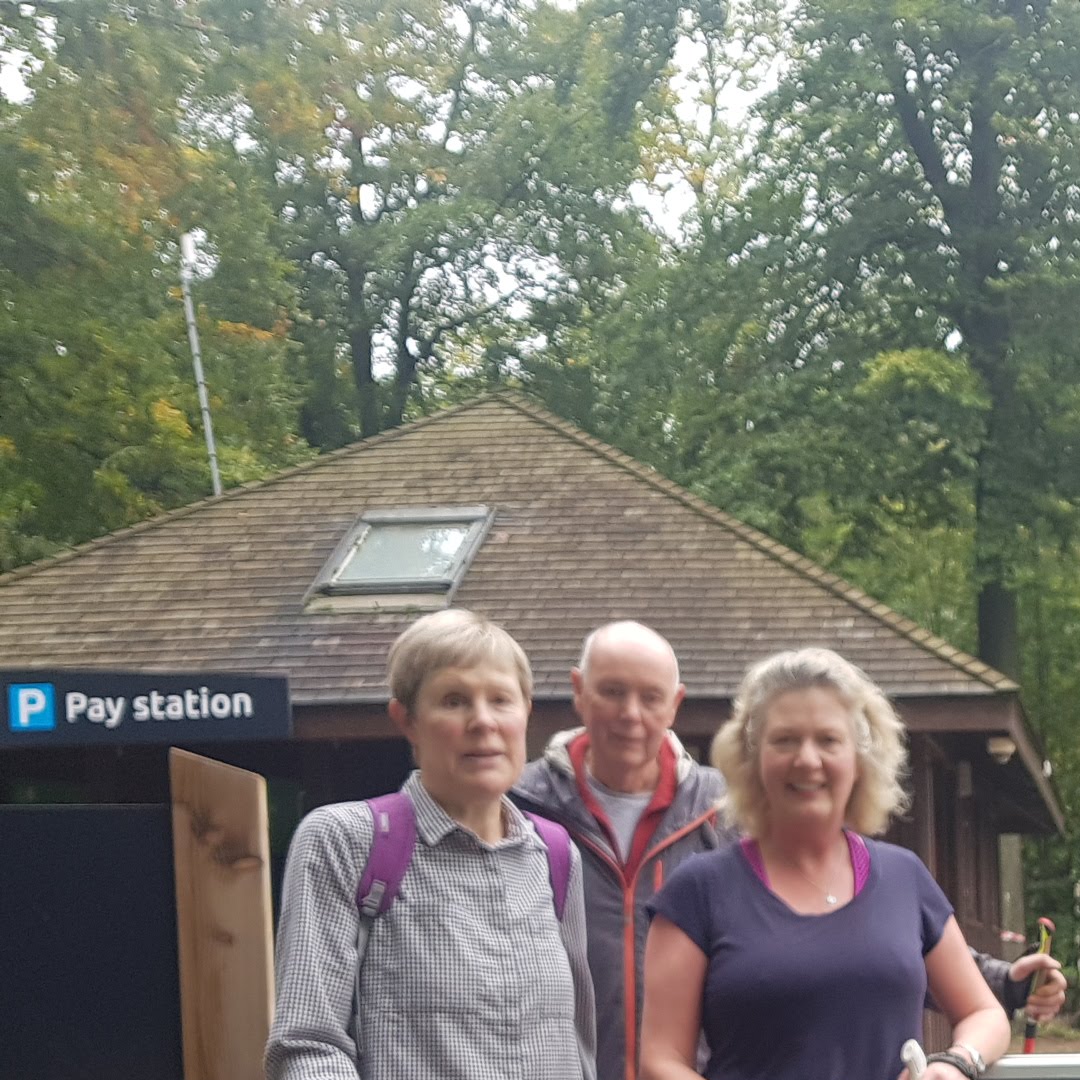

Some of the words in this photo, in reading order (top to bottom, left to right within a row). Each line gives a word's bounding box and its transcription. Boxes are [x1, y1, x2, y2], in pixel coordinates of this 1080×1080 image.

[18, 688, 46, 724] P
[65, 691, 125, 729] Pay
[132, 686, 254, 722] station
